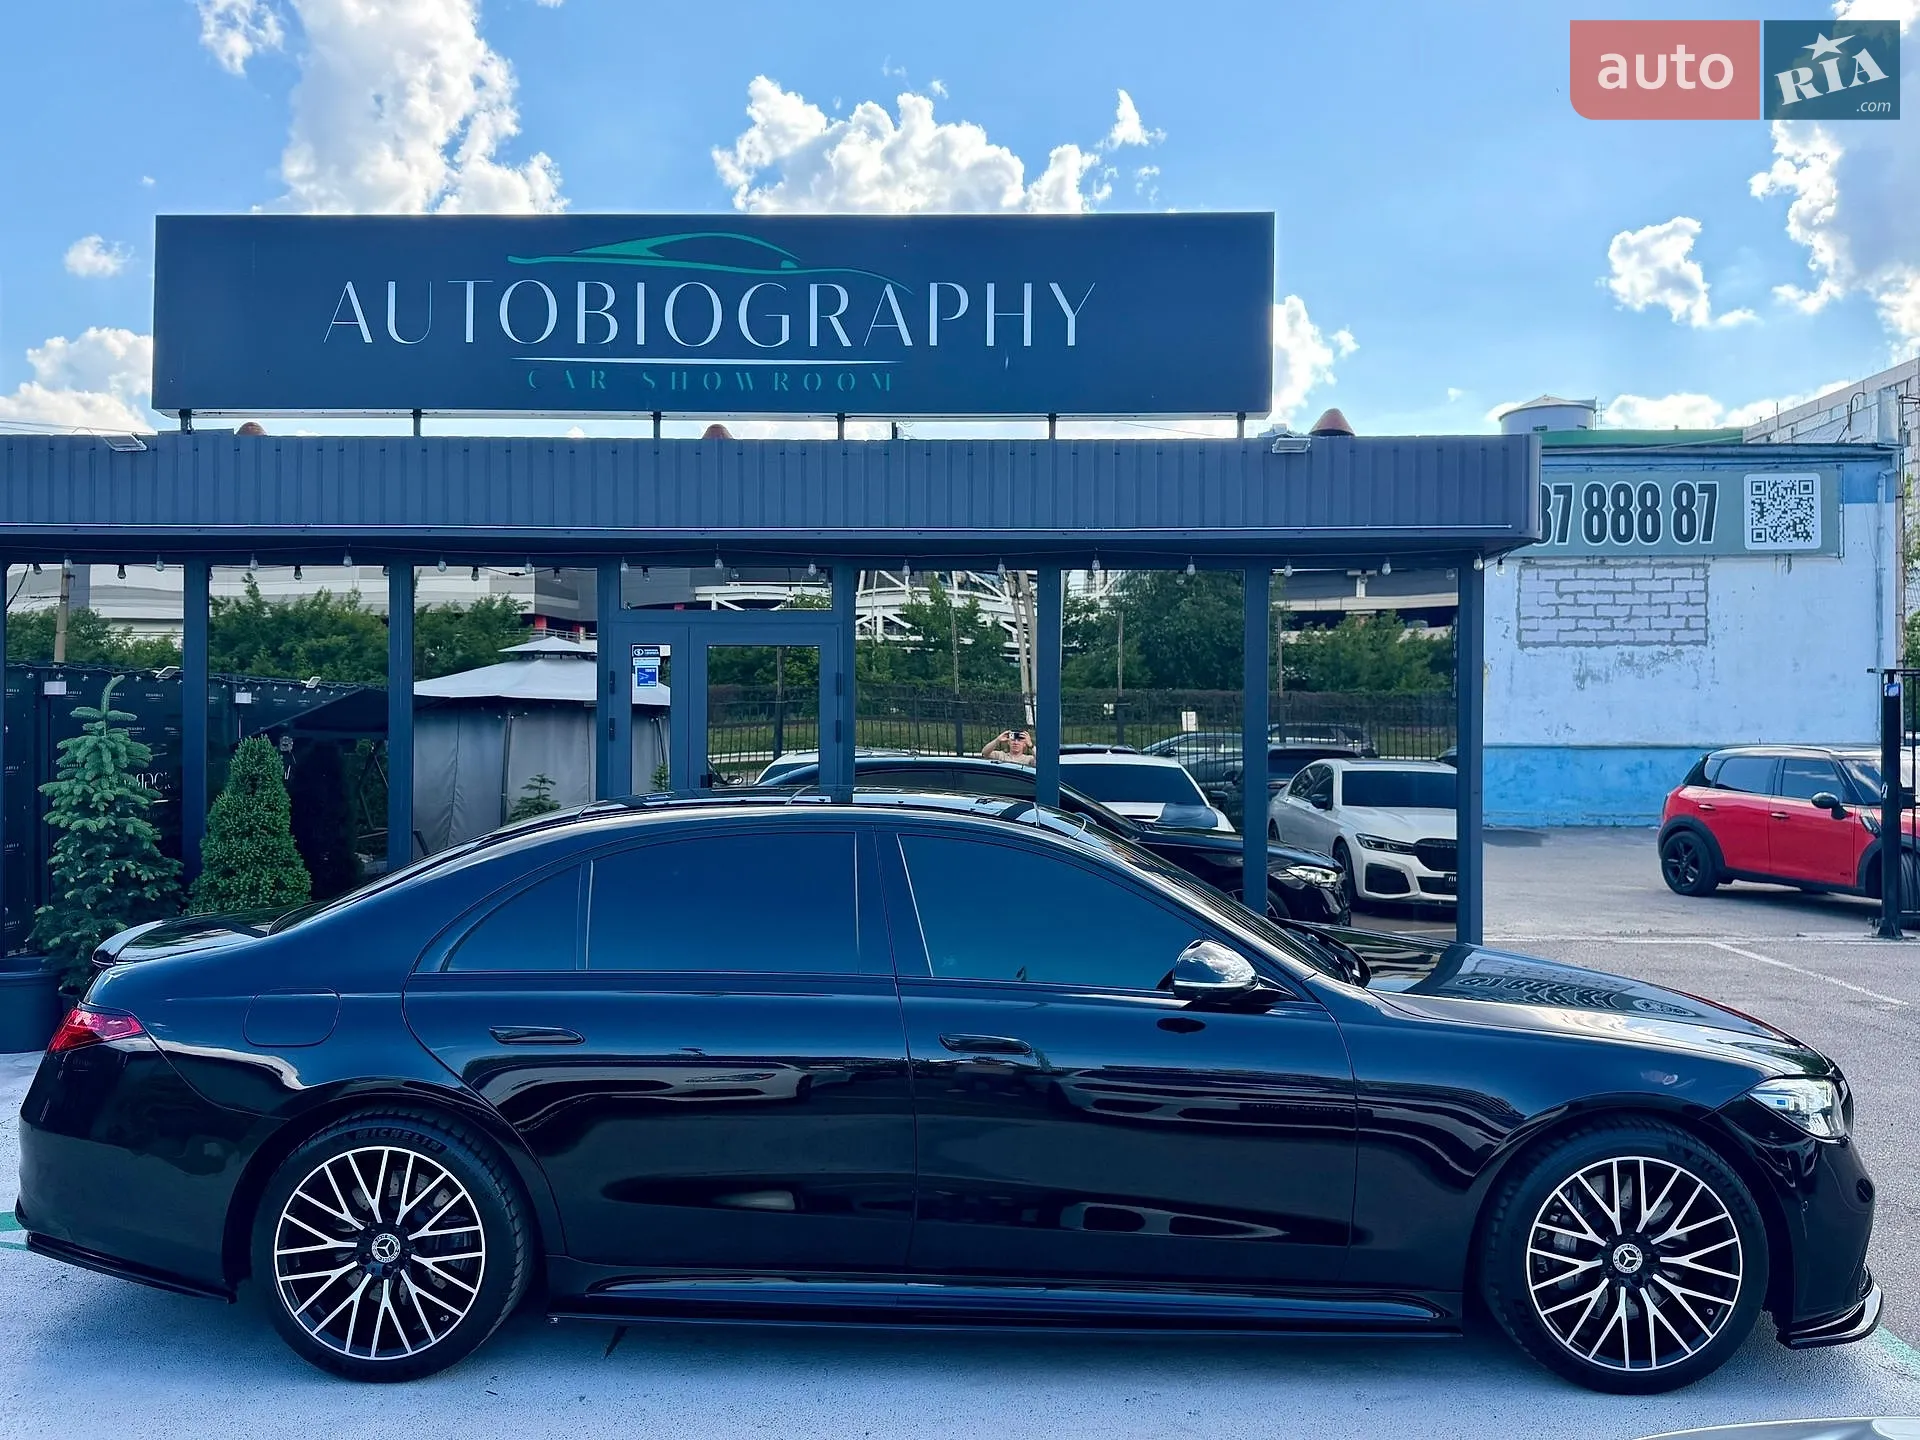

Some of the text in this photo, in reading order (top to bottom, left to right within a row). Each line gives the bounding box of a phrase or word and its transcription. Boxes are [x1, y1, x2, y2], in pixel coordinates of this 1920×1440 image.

[323, 279, 1096, 348] AUTOBIOGRAPHY
[528, 369, 891, 392] CAR SHOWROOM
[1581, 480, 1663, 546] 888
[1670, 480, 1720, 546] 87
